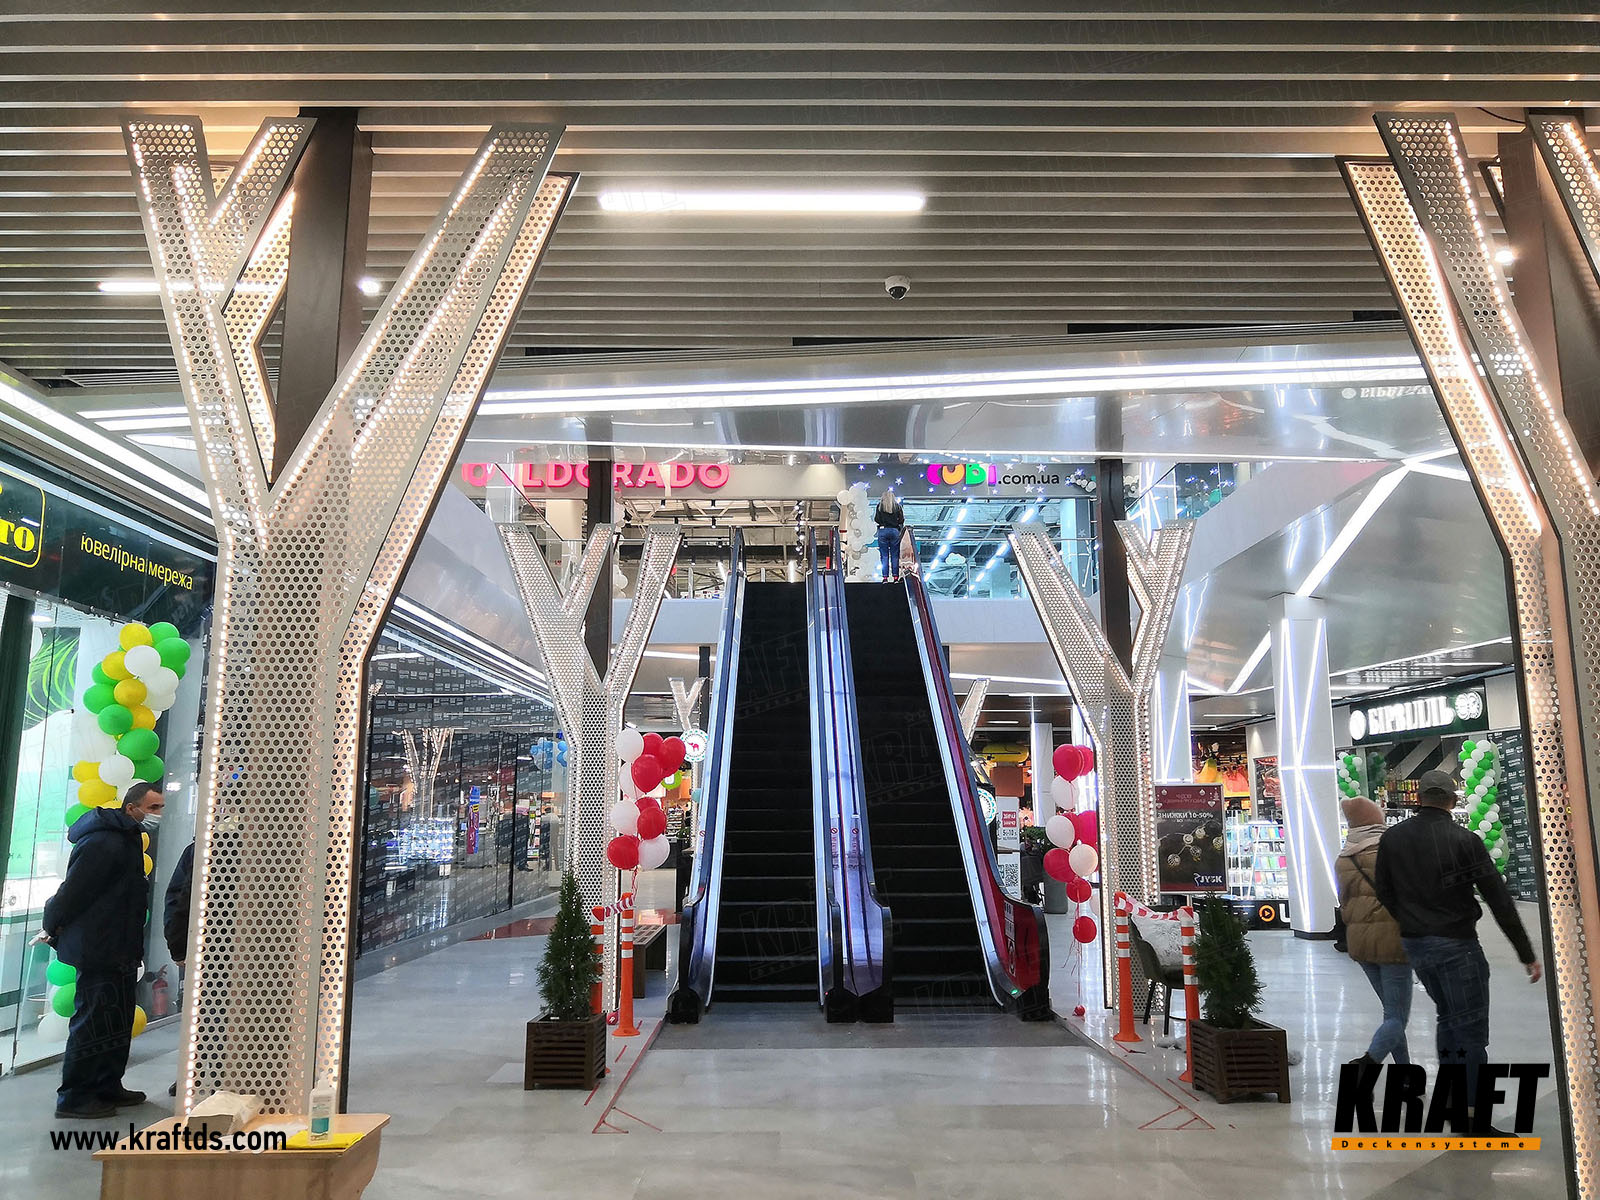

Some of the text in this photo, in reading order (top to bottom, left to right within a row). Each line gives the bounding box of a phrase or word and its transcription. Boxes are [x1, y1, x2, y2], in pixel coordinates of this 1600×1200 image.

[80, 534, 193, 590] ювелірна мережа
[1199, 875, 1223, 884] JYSK
